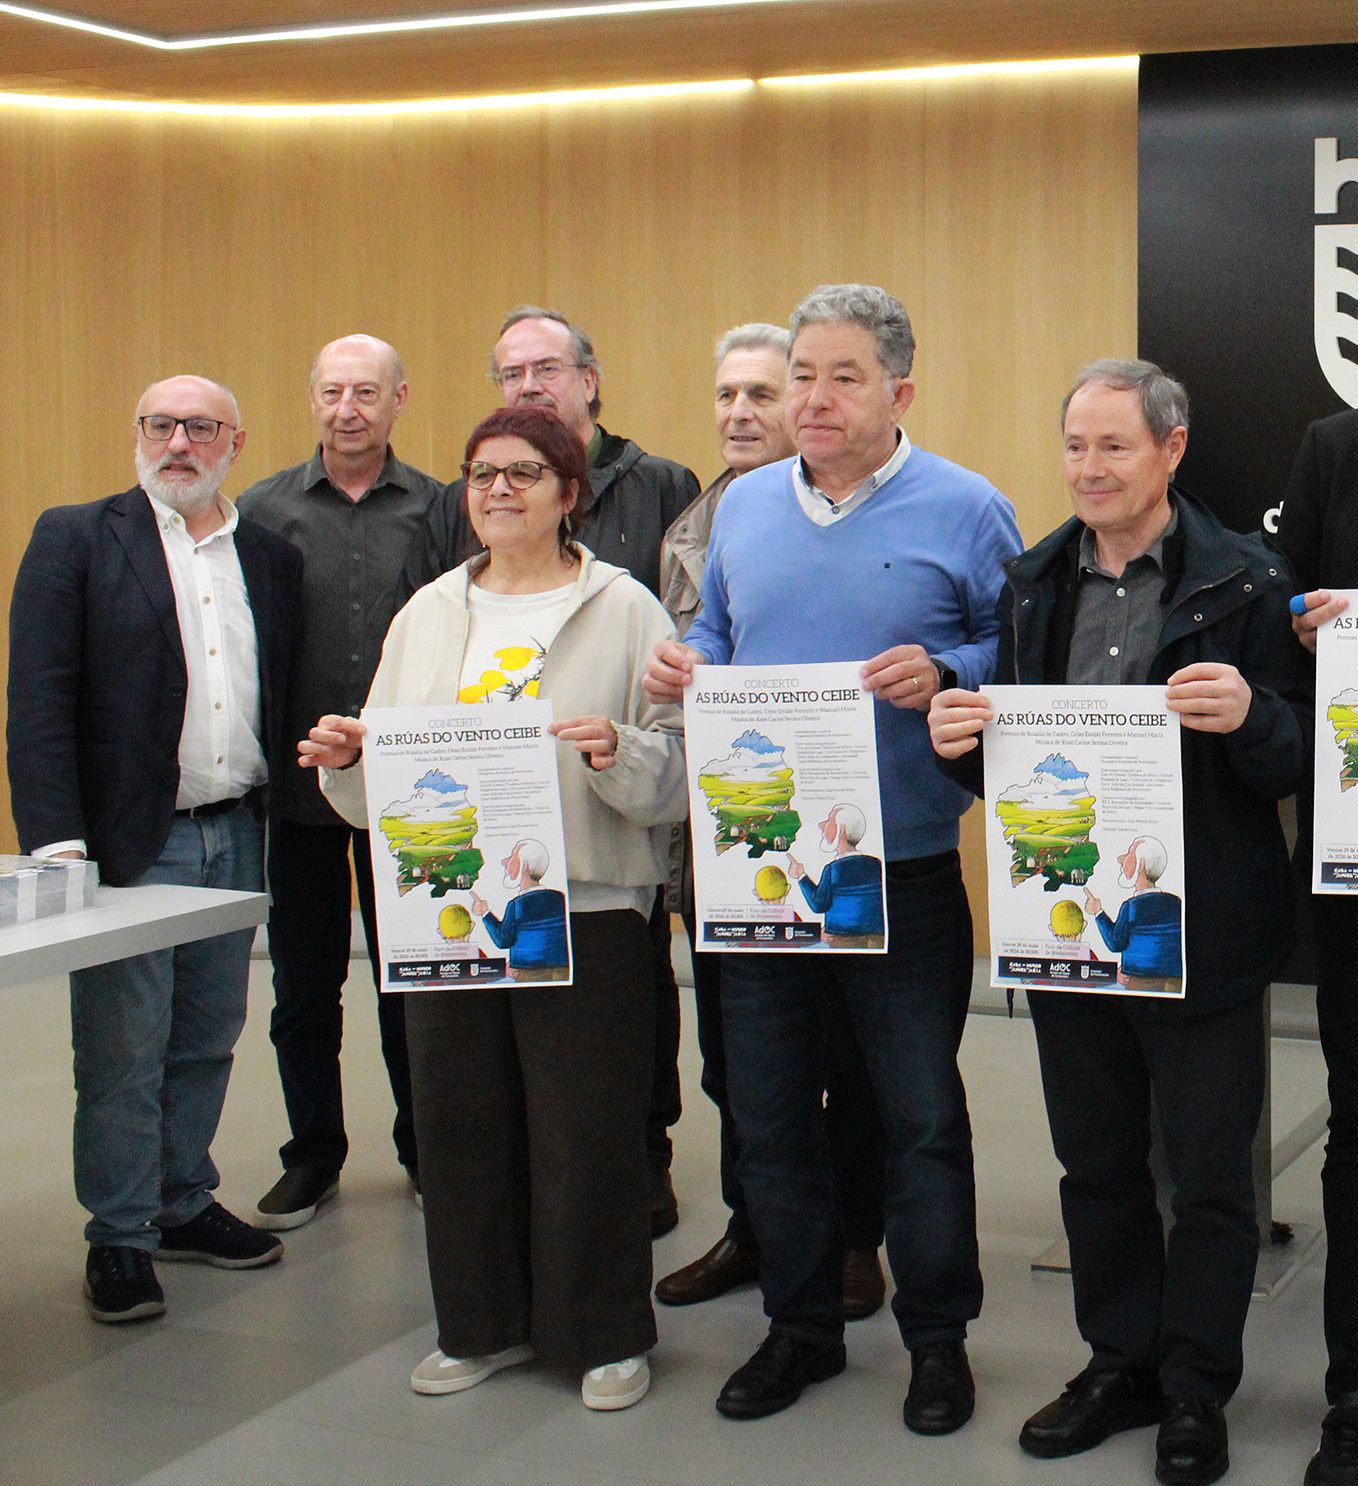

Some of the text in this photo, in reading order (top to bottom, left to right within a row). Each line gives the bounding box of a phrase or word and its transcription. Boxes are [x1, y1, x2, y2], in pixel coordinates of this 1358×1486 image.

[1333, 617, 1353, 629] AS
[744, 679, 799, 688] CONCERTO
[696, 689, 860, 704] AS RÚAS DO VENTO CEIBE
[1052, 700, 1108, 710] CONCERTO
[428, 717, 482, 728] CONCERTO
[996, 711, 1167, 726] AS RÚAS DO VENTO CEIBE
[376, 726, 542, 746] AS RÚAS DO VENTO CEIBE
